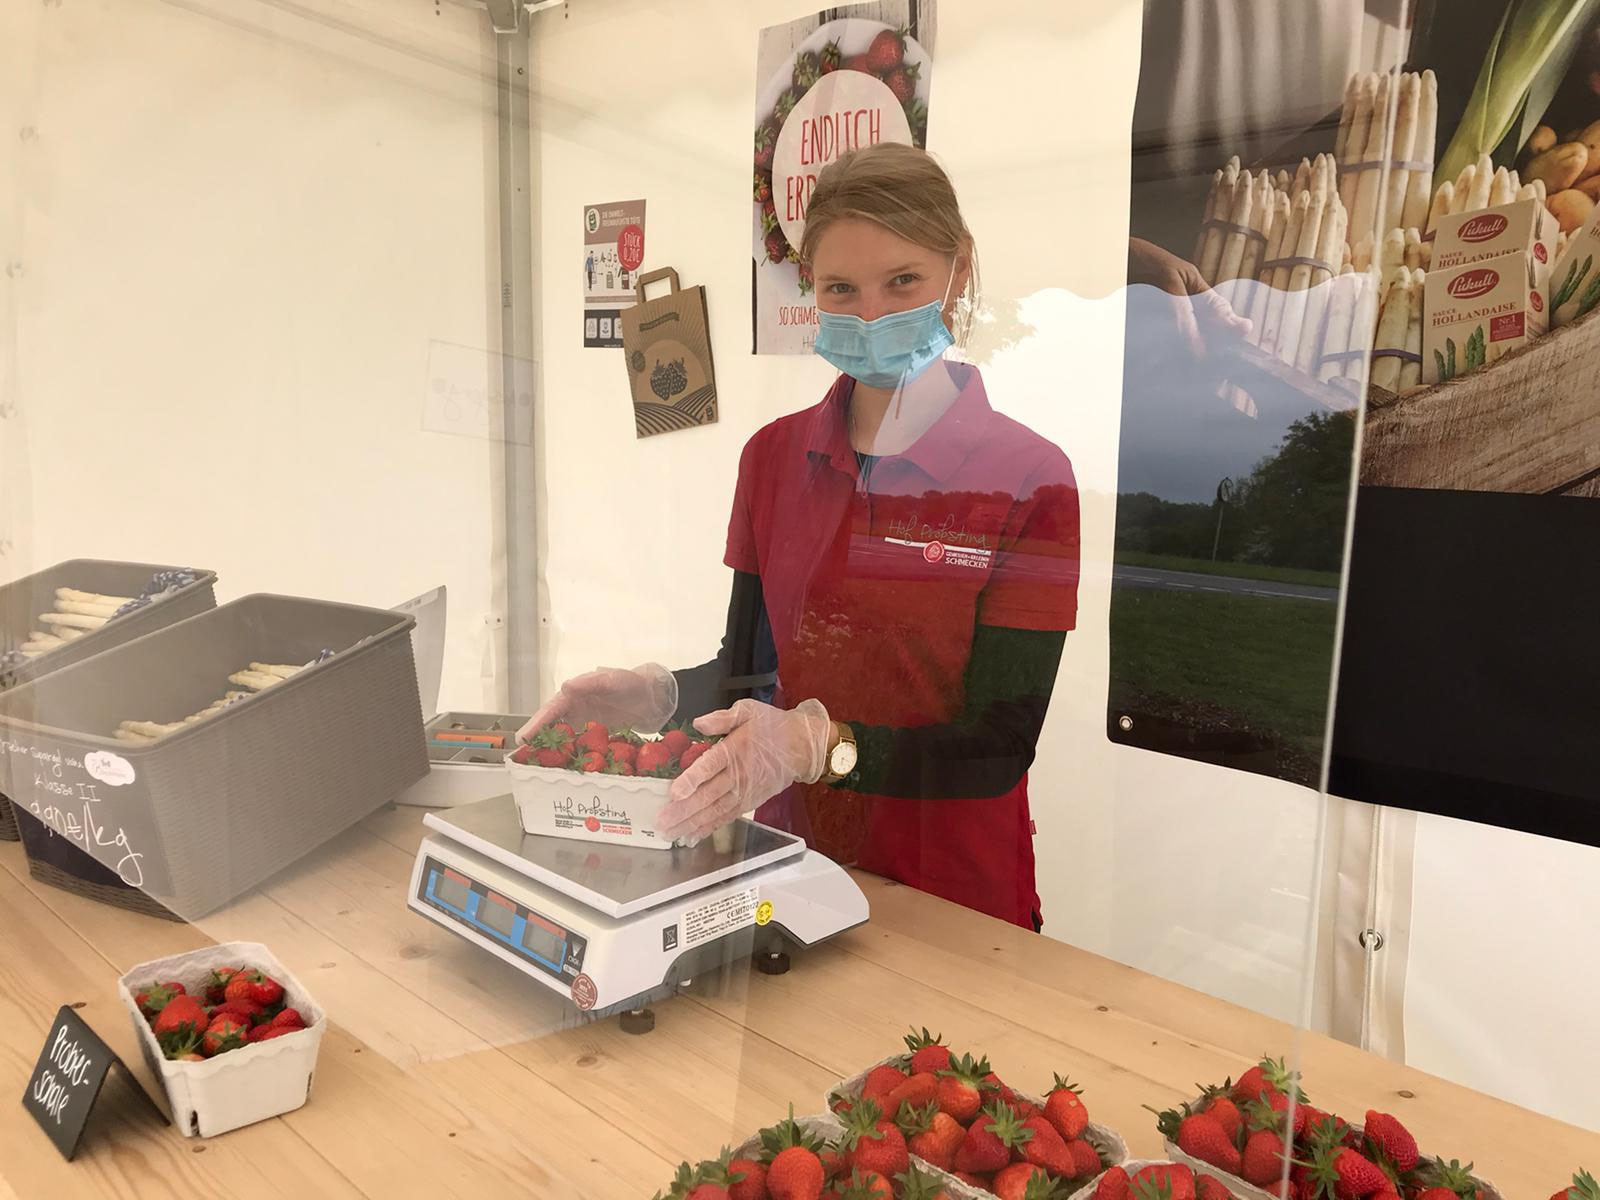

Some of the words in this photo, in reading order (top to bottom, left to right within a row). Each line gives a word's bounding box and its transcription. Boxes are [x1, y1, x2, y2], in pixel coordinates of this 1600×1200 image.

[801, 108, 880, 165] ENDLICH
[1461, 218, 1504, 240] Lukull
[1440, 250, 1464, 259] SAUCE
[1450, 272, 1495, 297] Lukull
[779, 306, 789, 326] SO
[1432, 307, 1457, 317] SAUCE
[1432, 302, 1517, 326] HOLLANDAISE
[888, 514, 918, 545] Hof
[945, 557, 988, 569] SCHMECKEN
[34, 771, 73, 796] Klasse
[76, 782, 101, 802] II
[553, 796, 575, 819] Hof
